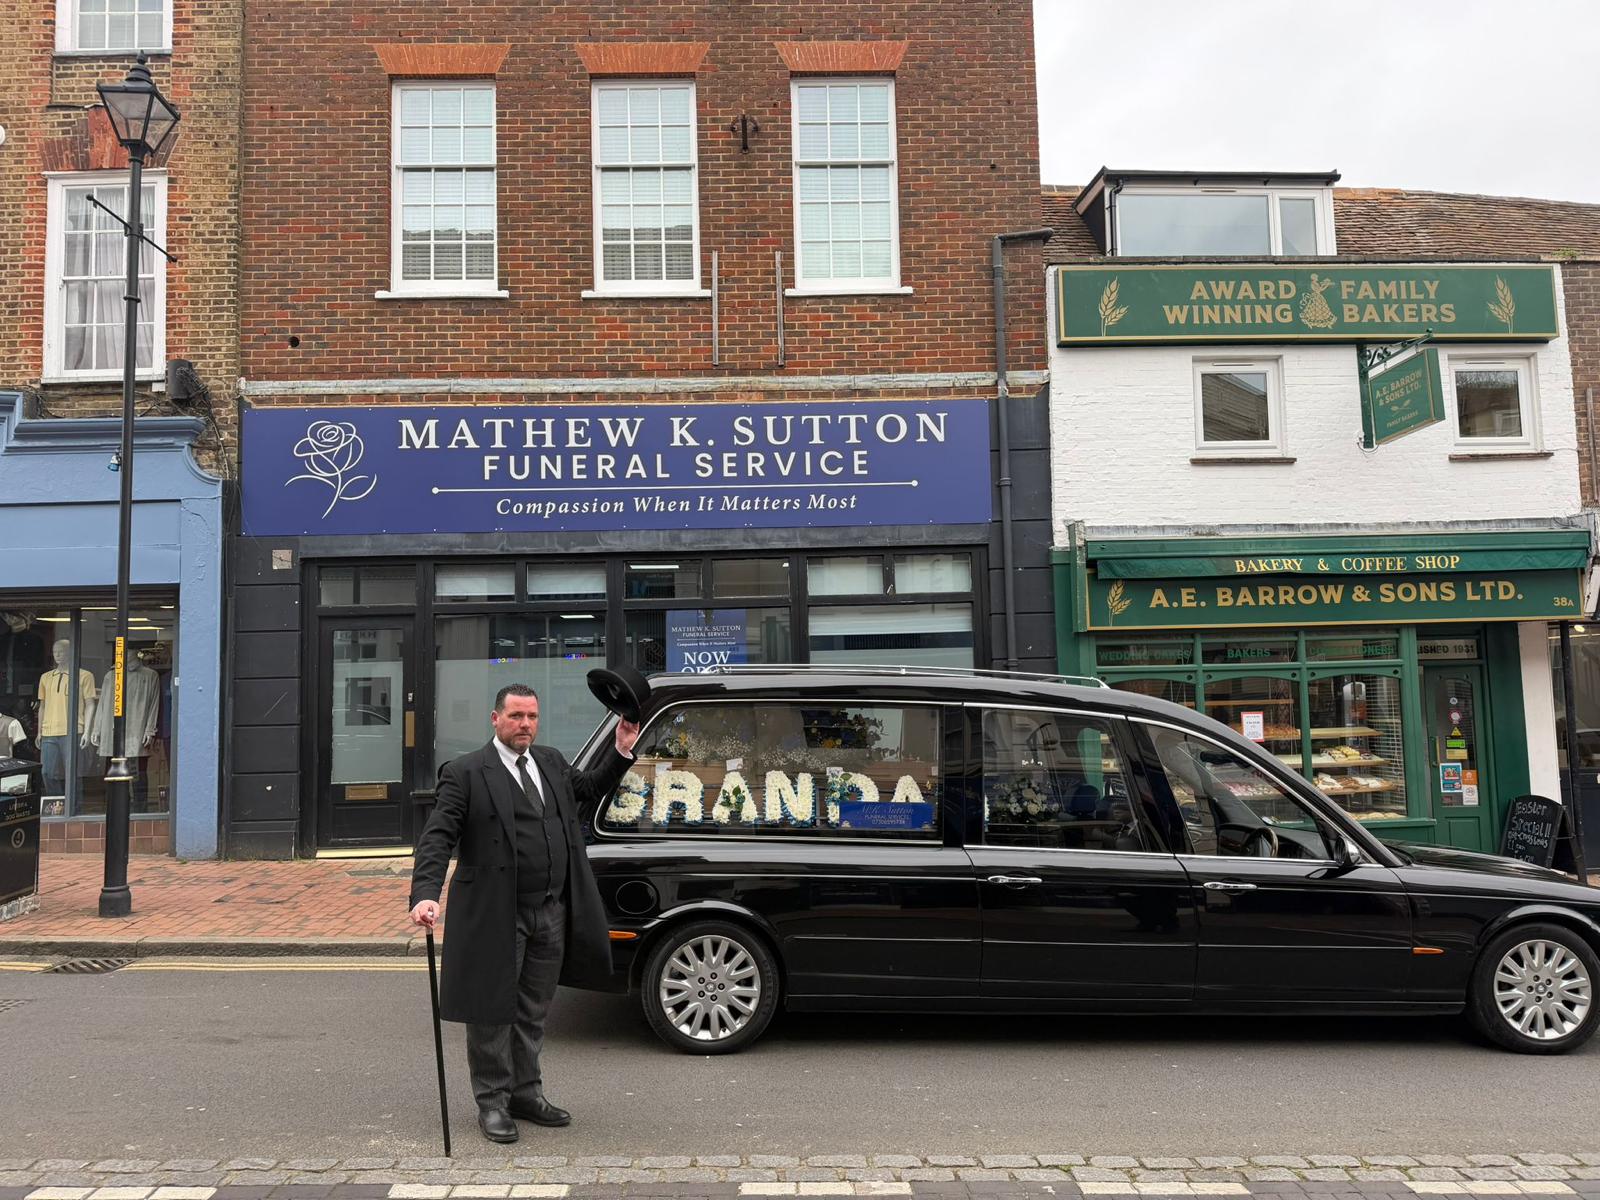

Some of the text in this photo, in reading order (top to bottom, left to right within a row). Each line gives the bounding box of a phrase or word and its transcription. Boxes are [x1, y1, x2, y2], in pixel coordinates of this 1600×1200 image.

[1191, 279, 1440, 300] AWARD FAMILY
[1163, 303, 1457, 325] WINNING BAKERS
[1390, 369, 1422, 391] BARROW
[1385, 388, 1405, 404] SONS
[398, 412, 949, 449] MATHEW K. SUTTON
[483, 450, 869, 481] FUNERAL SERVICE
[496, 492, 858, 519] Compassion When It Matters Most
[1234, 554, 1460, 573] BAKERY & COFFEE SHOP
[1149, 580, 1524, 609] A.E. BARROW & SONS LTD.
[684, 651, 731, 665] NOW
[1227, 648, 1271, 658] BAKERS
[1515, 801, 1548, 816] Easter
